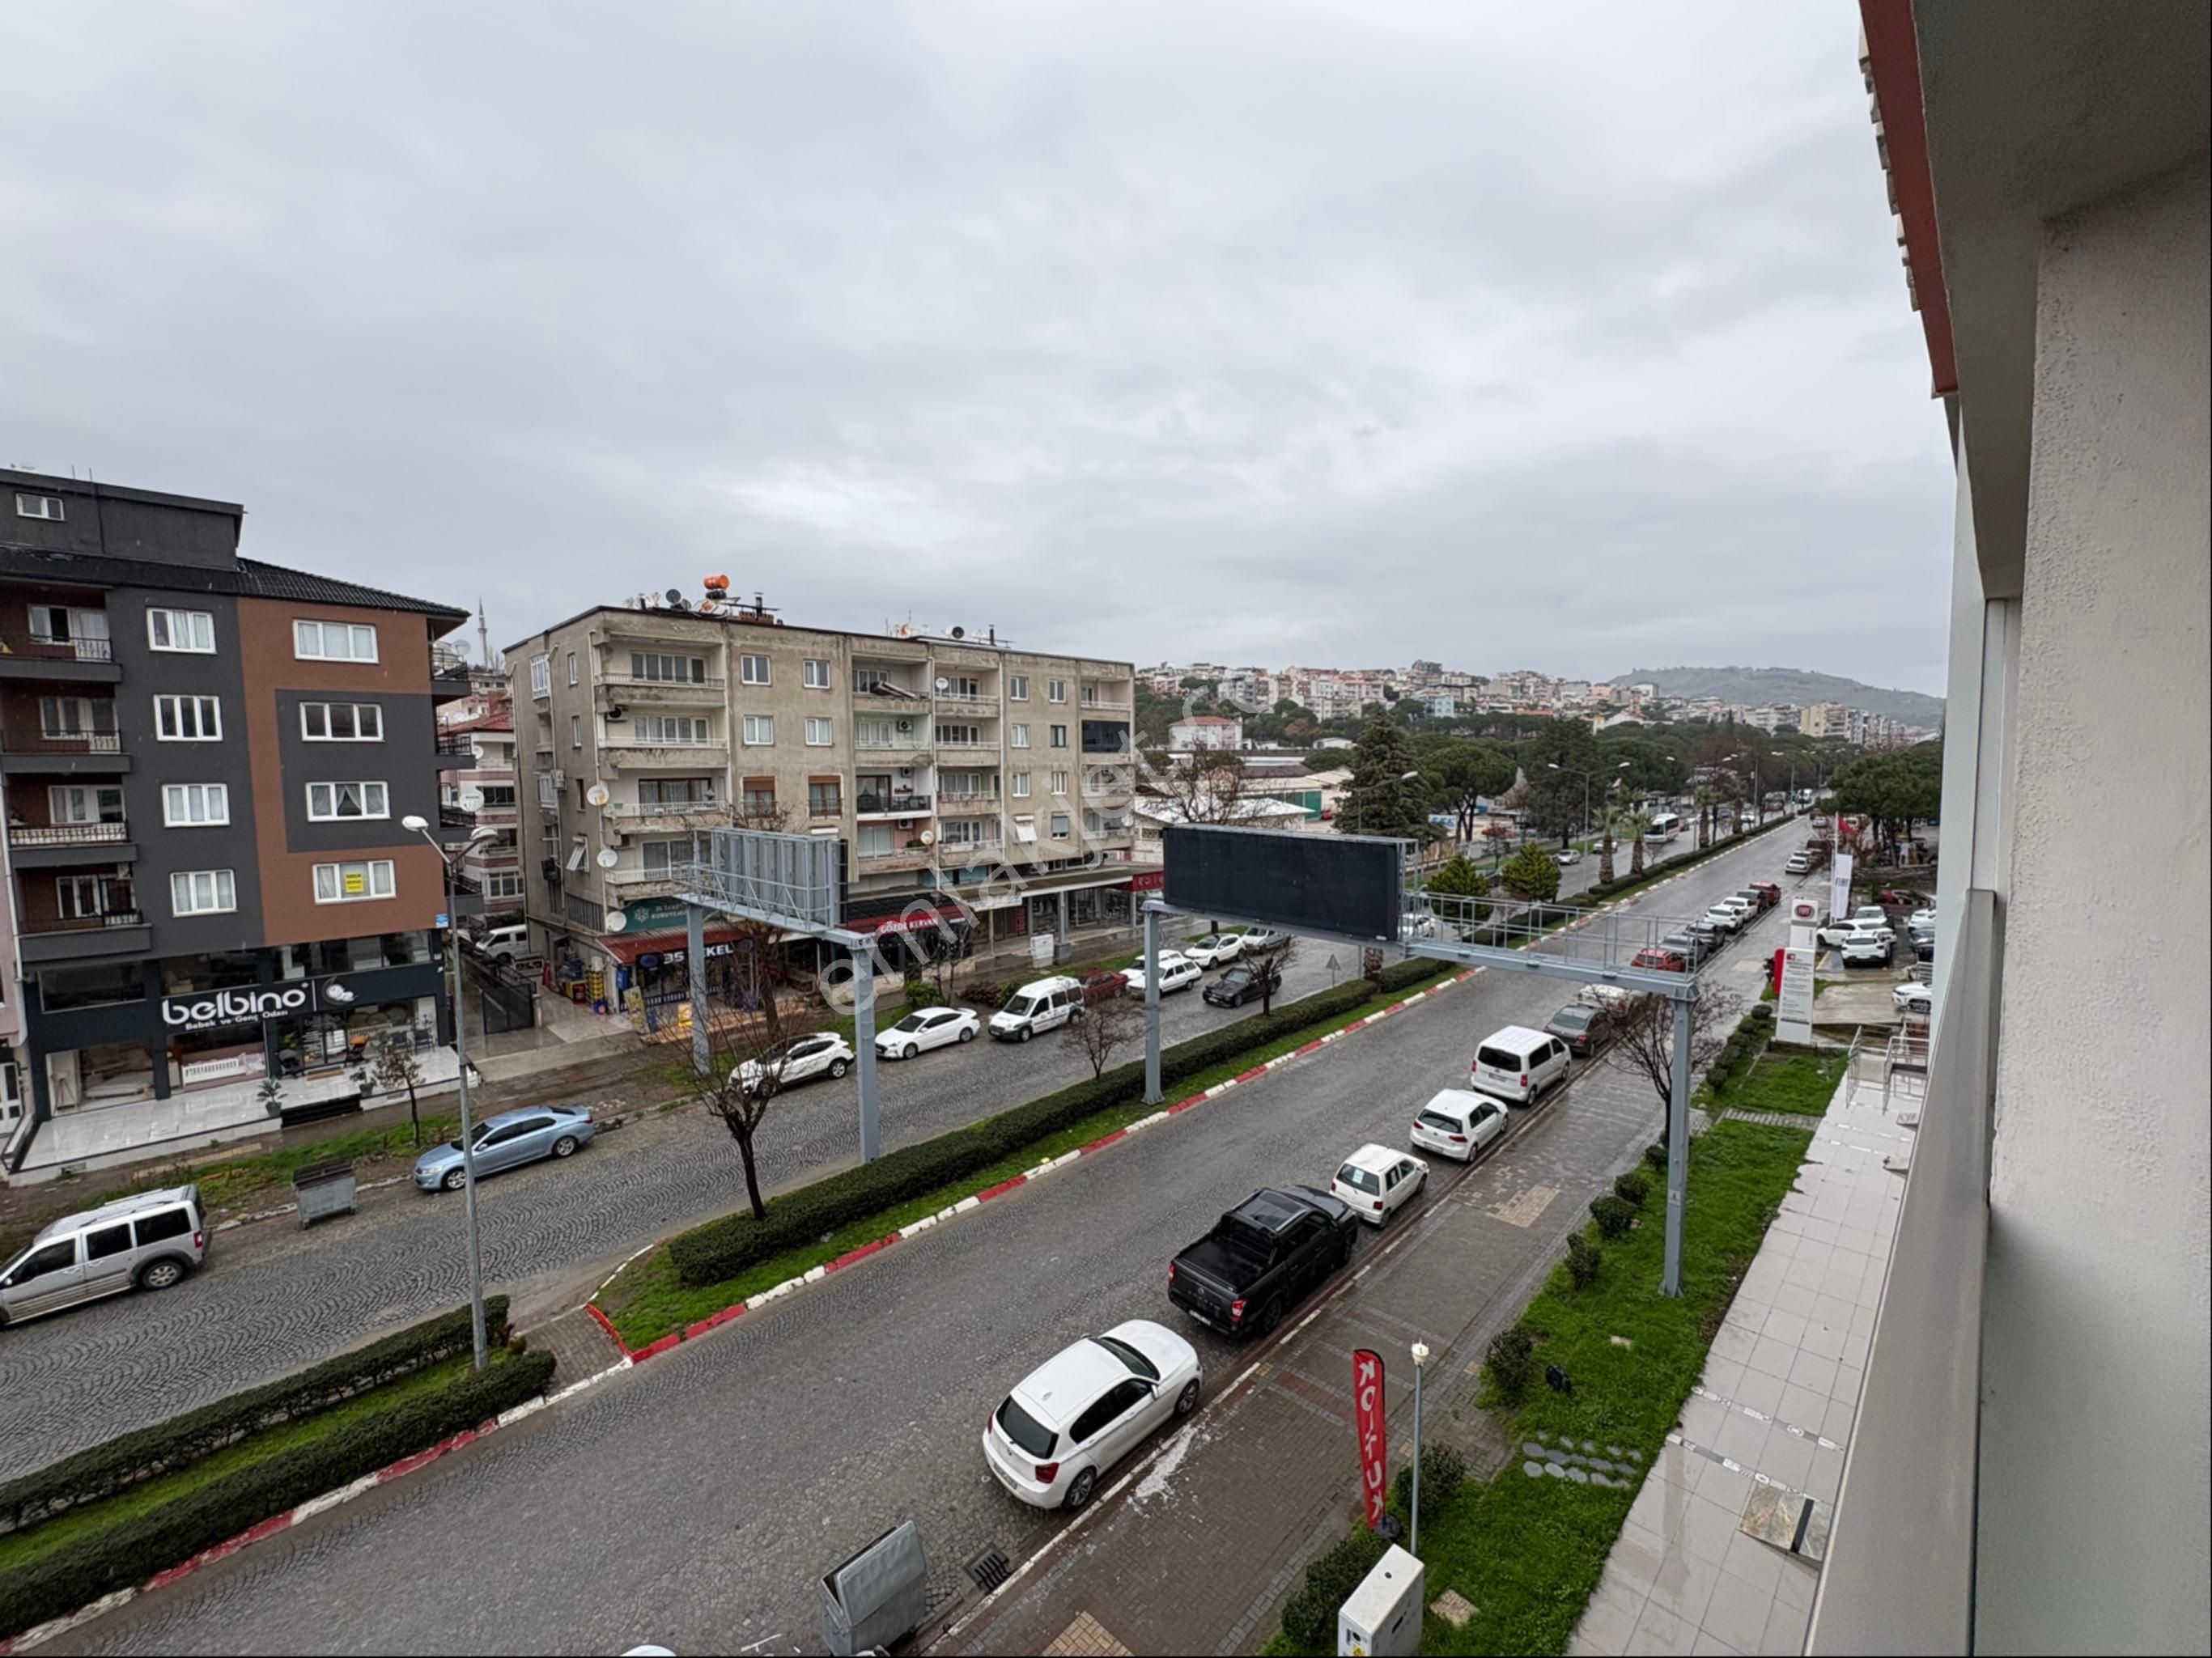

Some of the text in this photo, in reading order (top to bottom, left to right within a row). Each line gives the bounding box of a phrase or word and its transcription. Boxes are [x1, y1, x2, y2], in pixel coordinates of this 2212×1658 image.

[663, 951, 685, 965] 35
[162, 989, 306, 1024] belbino
[185, 1020, 217, 1031] Bebek
[235, 1013, 259, 1024] Genç
[261, 1009, 289, 1019] Odası
